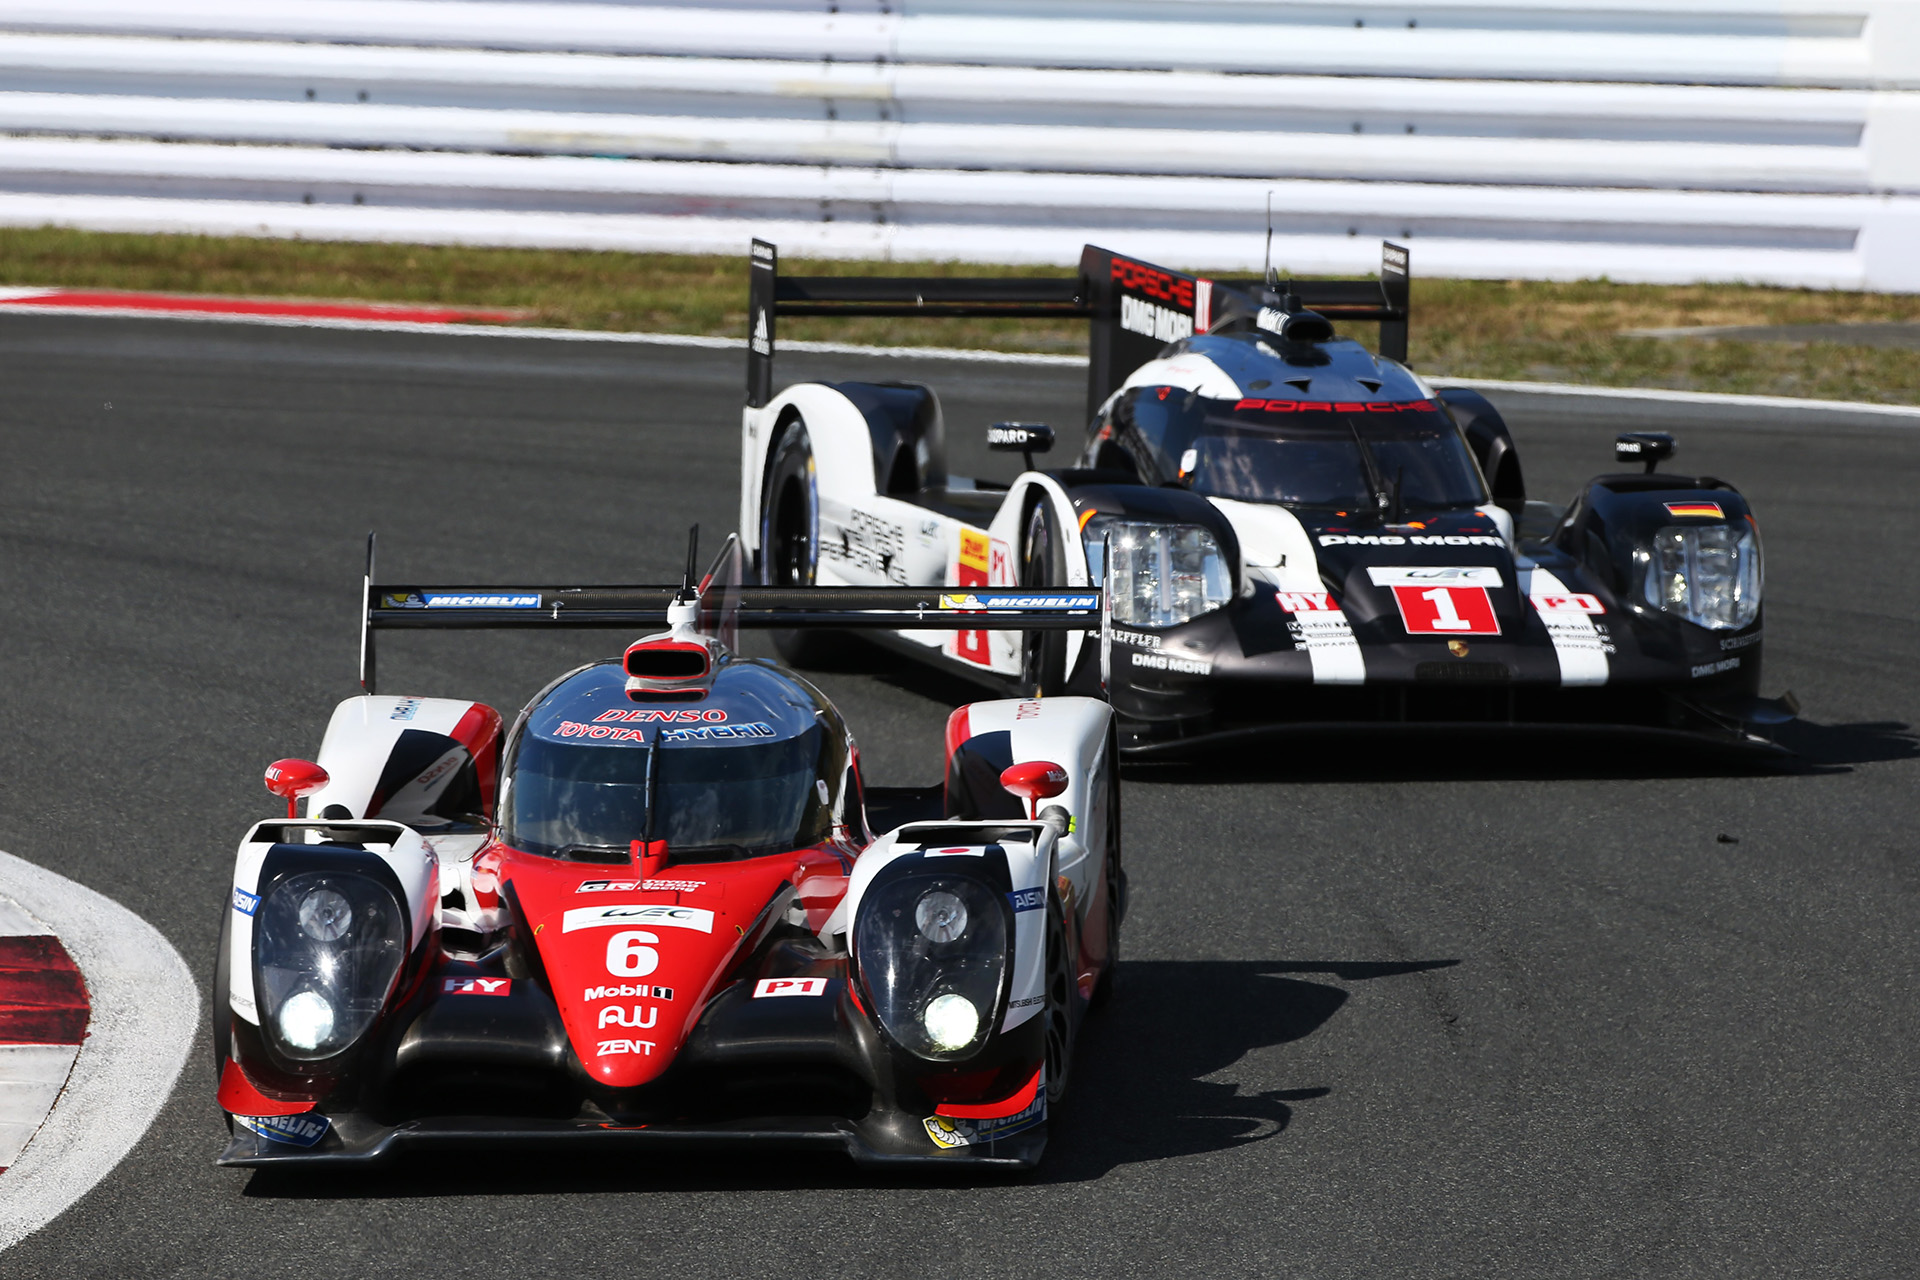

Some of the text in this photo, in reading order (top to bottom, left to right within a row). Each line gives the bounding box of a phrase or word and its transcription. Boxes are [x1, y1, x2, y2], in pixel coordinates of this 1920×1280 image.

[1111, 257, 1193, 308] PORSCHE
[1121, 294, 1155, 337] DMG
[1234, 398, 1438, 413] PORSCHE
[1318, 535, 1506, 548] DMG MORI
[428, 597, 538, 606] MICHELIN
[987, 598, 1095, 606] MICHELIN
[1275, 592, 1330, 611] HY
[1422, 588, 1472, 630] 1
[1543, 598, 1591, 610] P1
[1132, 653, 1213, 675] DMG MORI
[592, 709, 728, 722] DENSO
[552, 721, 645, 743] TOYOTA
[659, 722, 777, 743] HYBRID
[601, 907, 695, 919] WEC
[605, 930, 660, 978] 6
[444, 978, 502, 992] HY
[584, 984, 649, 1002] Mobil
[764, 980, 813, 994] P1
[596, 1039, 657, 1057] ZENT
